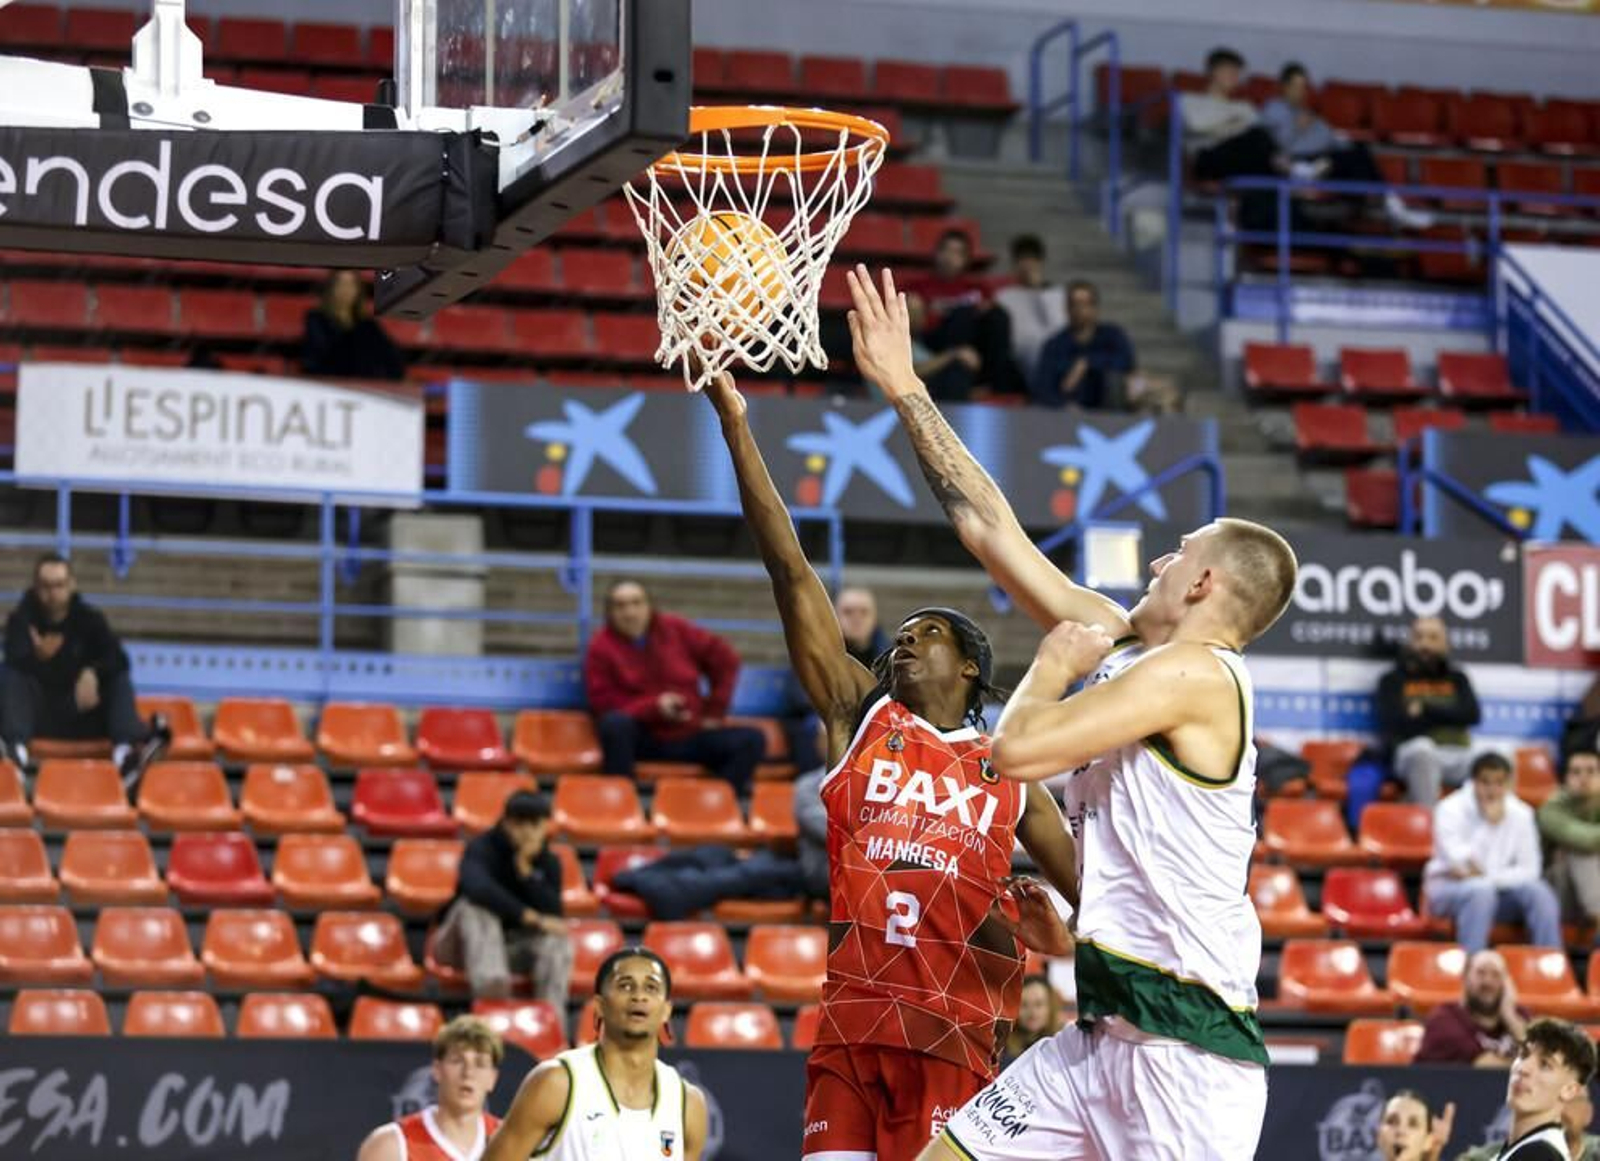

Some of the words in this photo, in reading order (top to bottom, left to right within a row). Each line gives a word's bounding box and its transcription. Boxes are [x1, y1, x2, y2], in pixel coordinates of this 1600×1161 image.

[0, 140, 384, 240] ndesa
[864, 758, 999, 836] BAXI
[865, 835, 960, 879] MANRESA
[885, 890, 920, 948] 2
